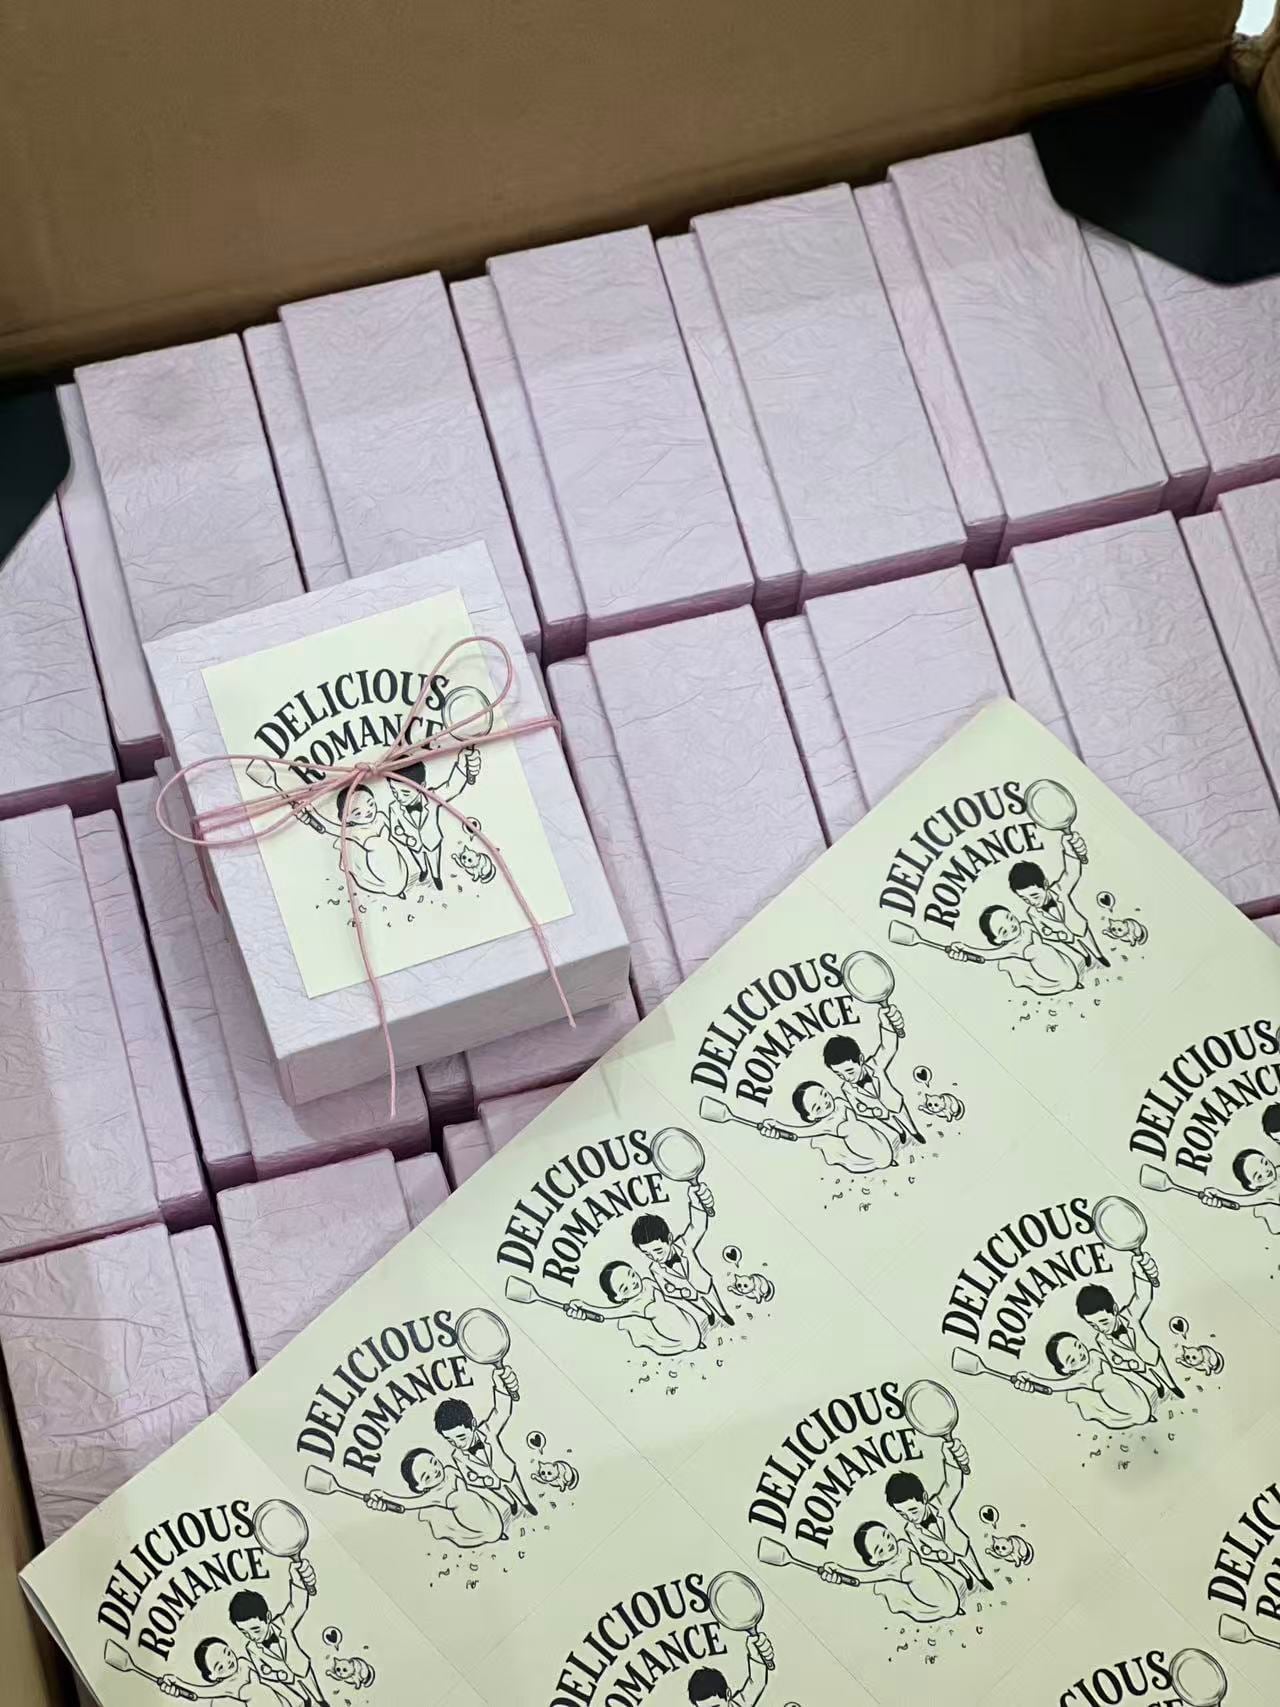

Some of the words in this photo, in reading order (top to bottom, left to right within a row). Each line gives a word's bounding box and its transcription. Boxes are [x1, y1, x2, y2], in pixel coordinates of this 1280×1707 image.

[254, 668, 450, 759] DELICIOUS
[879, 781, 1027, 917] DELICIOUS
[924, 822, 1044, 930] ROMANCE
[690, 952, 843, 1093] DELICIOUS
[736, 995, 861, 1108] ROMANCE
[1129, 1019, 1280, 1161] DELICIOUS
[496, 1129, 653, 1273] DELICIOUS
[542, 1173, 670, 1288] ROMANCE
[941, 1198, 1095, 1344] DELICIOUS
[988, 1242, 1113, 1359] ROMANCE
[296, 1310, 458, 1462] DELICIOUS
[343, 1355, 474, 1477] ROMANCE
[749, 1381, 906, 1534] DELICIOUS
[796, 1428, 924, 1550] ROMANCE
[97, 1500, 255, 1639] DELICIOUS
[137, 1547, 270, 1661] ROMANCE
[549, 1573, 710, 1707] ELICIOUS
